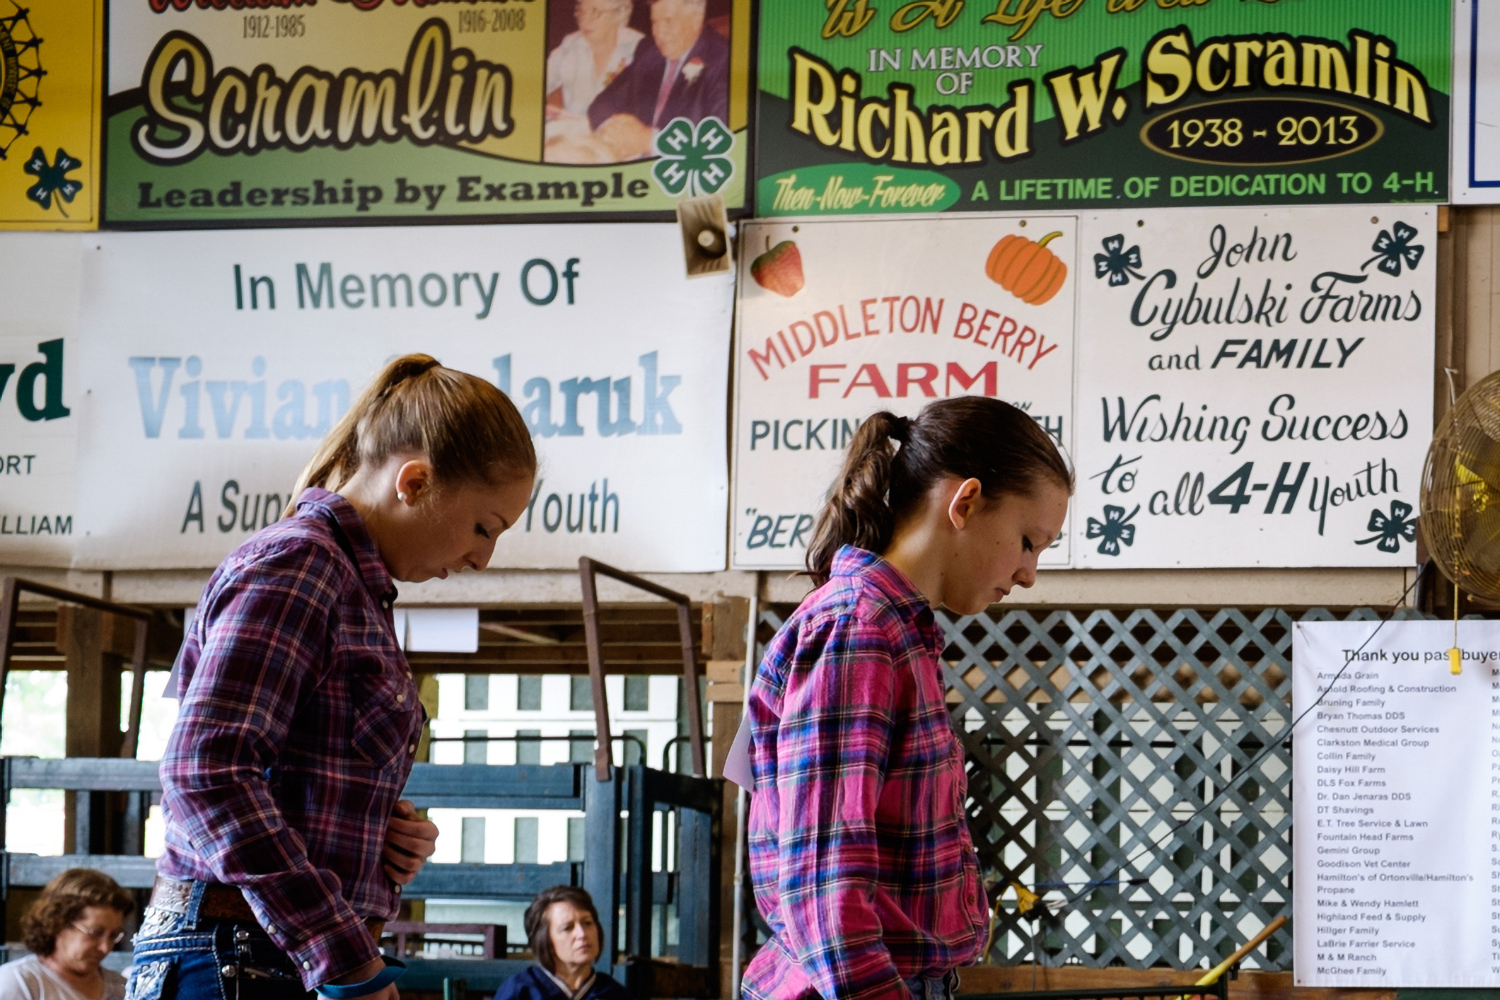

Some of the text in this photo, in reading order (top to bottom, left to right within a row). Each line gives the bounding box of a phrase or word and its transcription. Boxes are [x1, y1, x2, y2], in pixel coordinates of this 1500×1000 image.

[242, 8, 526, 38] 1912-1985 1916-2008
[869, 44, 1044, 73] IN MEMORY
[133, 18, 513, 164] Scramlin
[790, 31, 1434, 166] Richard W. Scramlin
[936, 71, 974, 96] OF
[1166, 119, 1244, 149] 1938
[1277, 115, 1360, 146] 2013
[137, 174, 650, 212] Leadership by Example
[970, 172, 1434, 201] A LIFETIME OF DEDICATION TO 4-H
[1199, 224, 1298, 279] John
[235, 258, 580, 319] In Memory Of
[1130, 268, 1423, 342] Cybulski Farms
[747, 296, 1060, 382] MIDDLETON BERRY
[1148, 337, 1365, 373] and FAMILY
[130, 355, 350, 440] Vivian
[808, 361, 999, 399] FARM
[1101, 394, 1251, 454] Wishing
[1261, 393, 1410, 443] Success
[1089, 454, 1143, 495] to
[1148, 471, 1205, 516] all
[1206, 462, 1311, 515] 4-H
[181, 482, 213, 533] A
[1342, 649, 1389, 661] Thank
[1392, 651, 1420, 664] you
[1424, 652, 1452, 664] pas
[1317, 713, 1344, 722] Bryan
[1401, 739, 1429, 749] Group
[1317, 766, 1342, 776] Daisy
[1332, 807, 1374, 816] Shavings
[1317, 887, 1355, 896] Propane
[1350, 900, 1381, 910] Wendy
[1317, 914, 1357, 923] Highland
[1395, 914, 1426, 923] Supply
